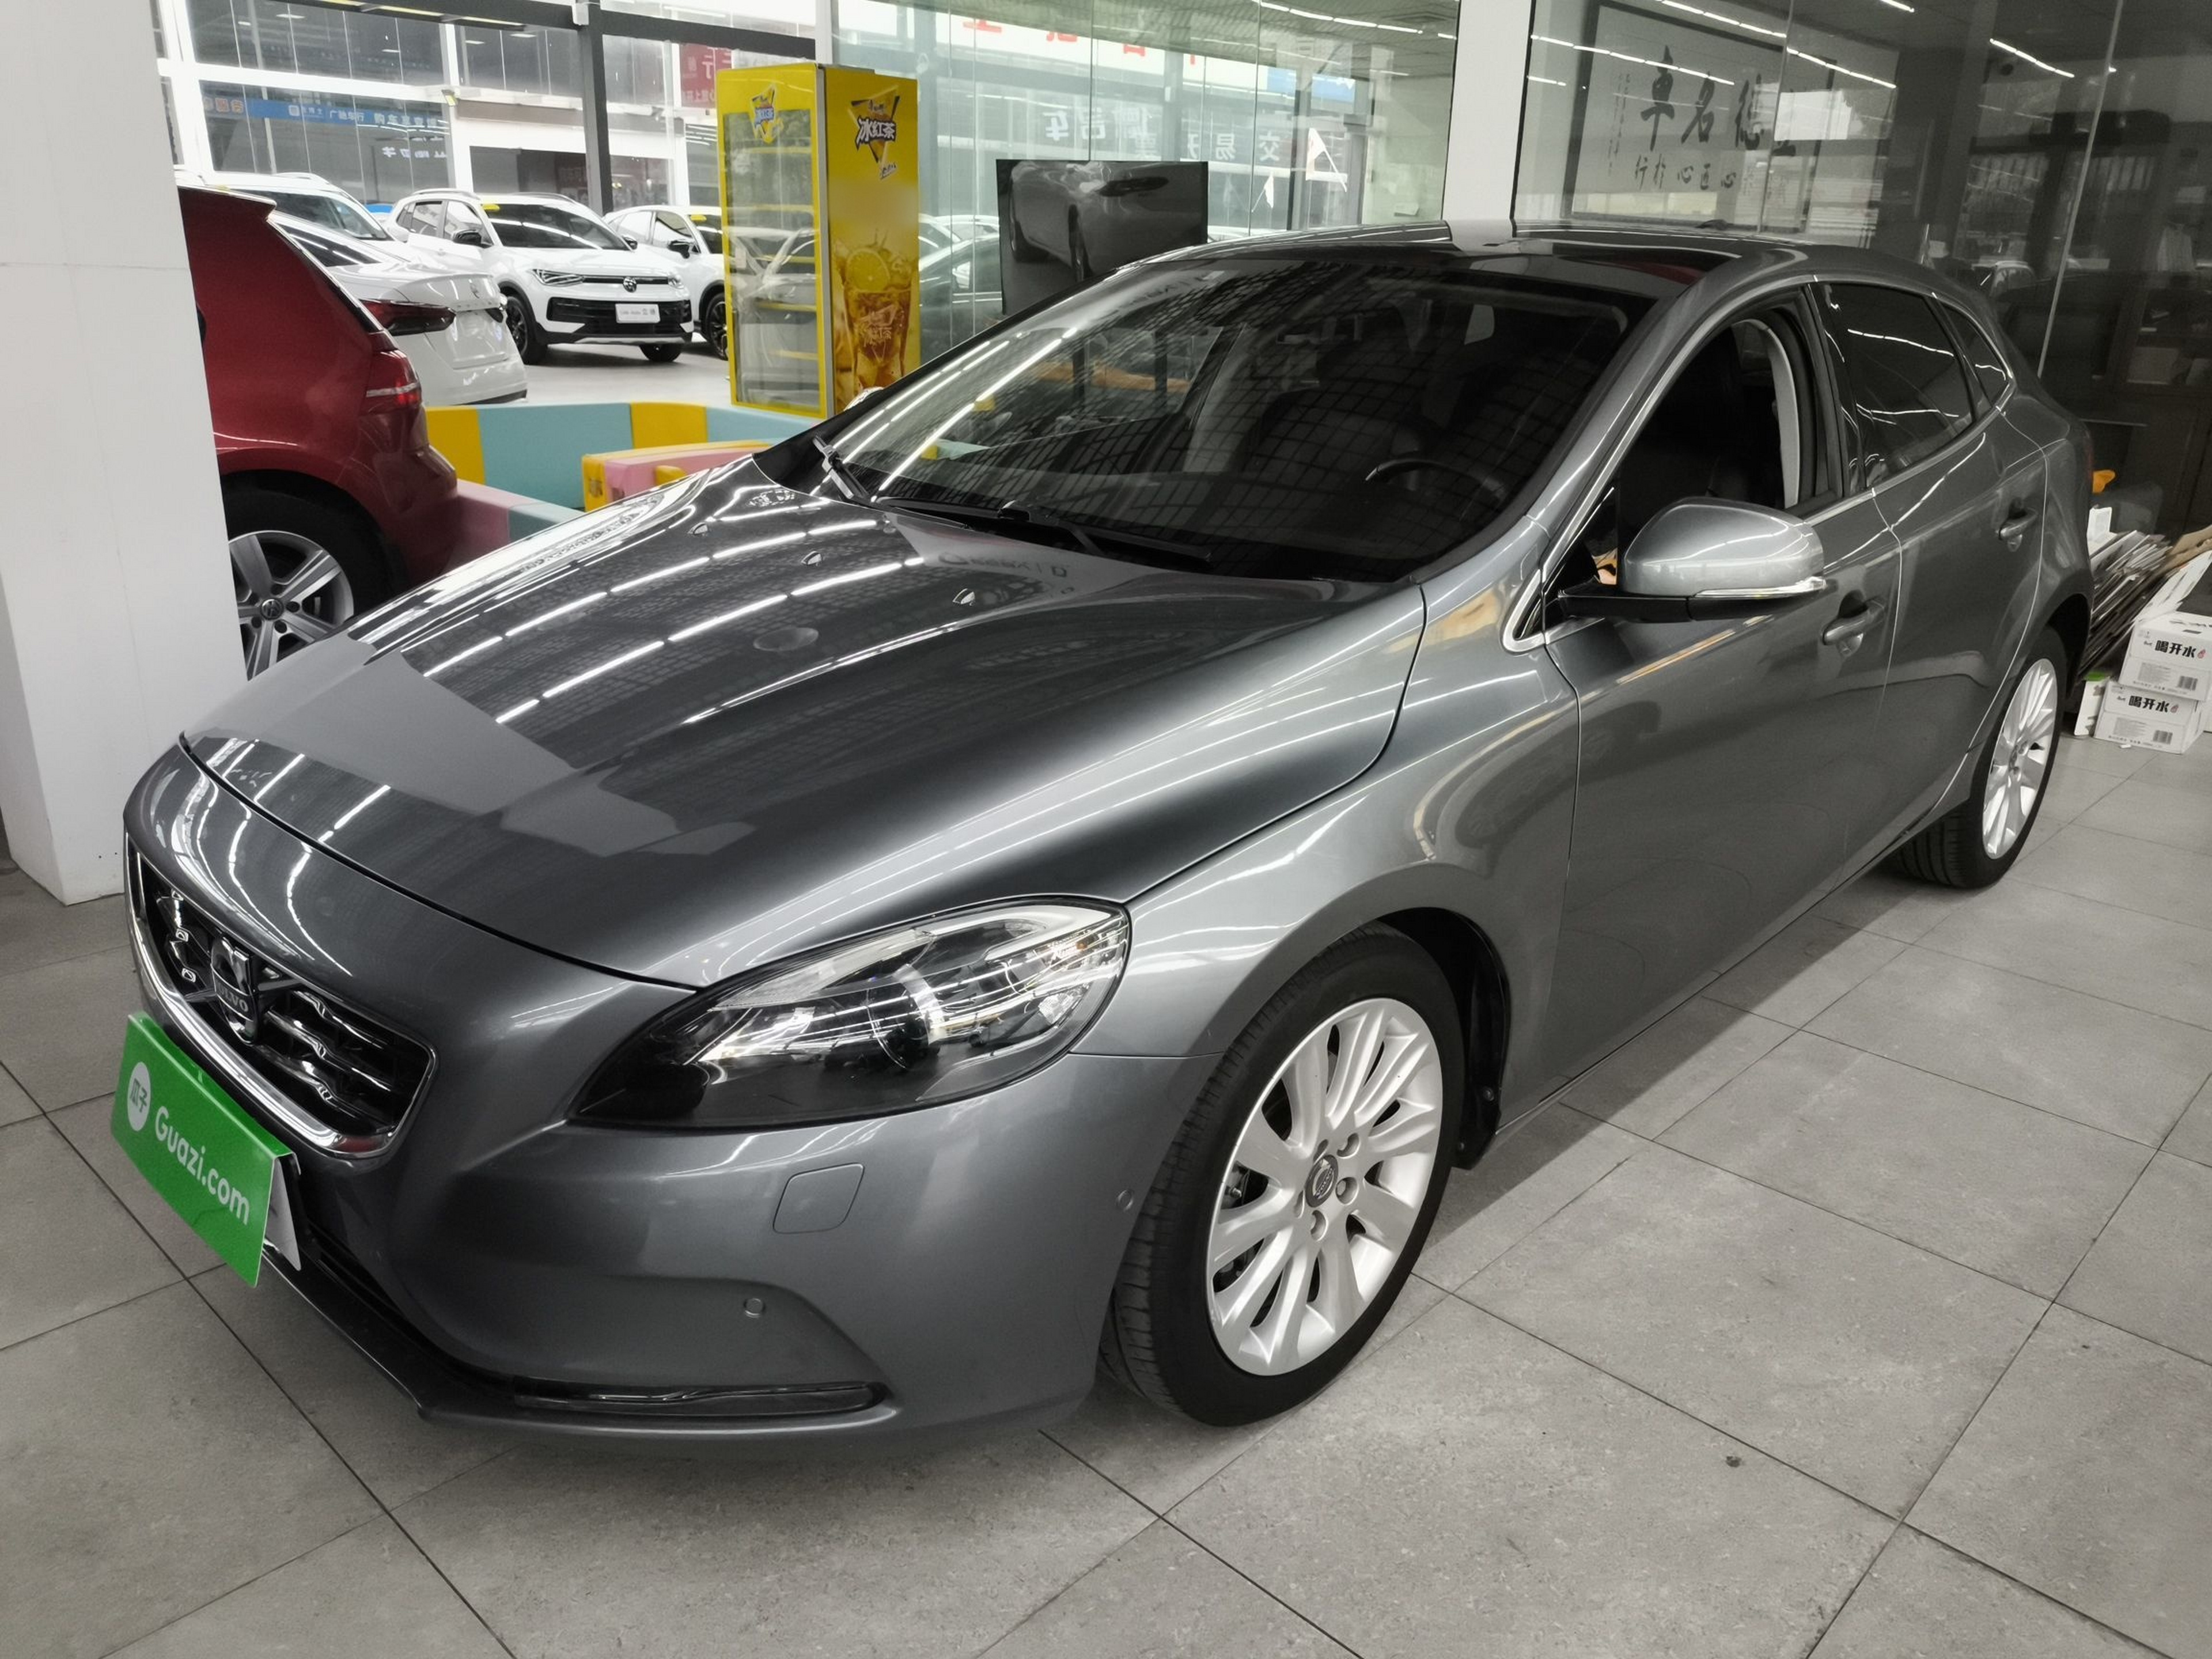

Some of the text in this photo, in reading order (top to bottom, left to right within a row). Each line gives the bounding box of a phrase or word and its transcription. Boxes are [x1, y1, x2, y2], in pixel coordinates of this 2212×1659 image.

[857, 118, 895, 144] 冰红茶
[2155, 639, 2196, 658] 喝开水
[2128, 695, 2170, 713] 喝开水
[129, 1078, 147, 1113] 瓜子
[155, 1105, 250, 1225] Guazi.com
